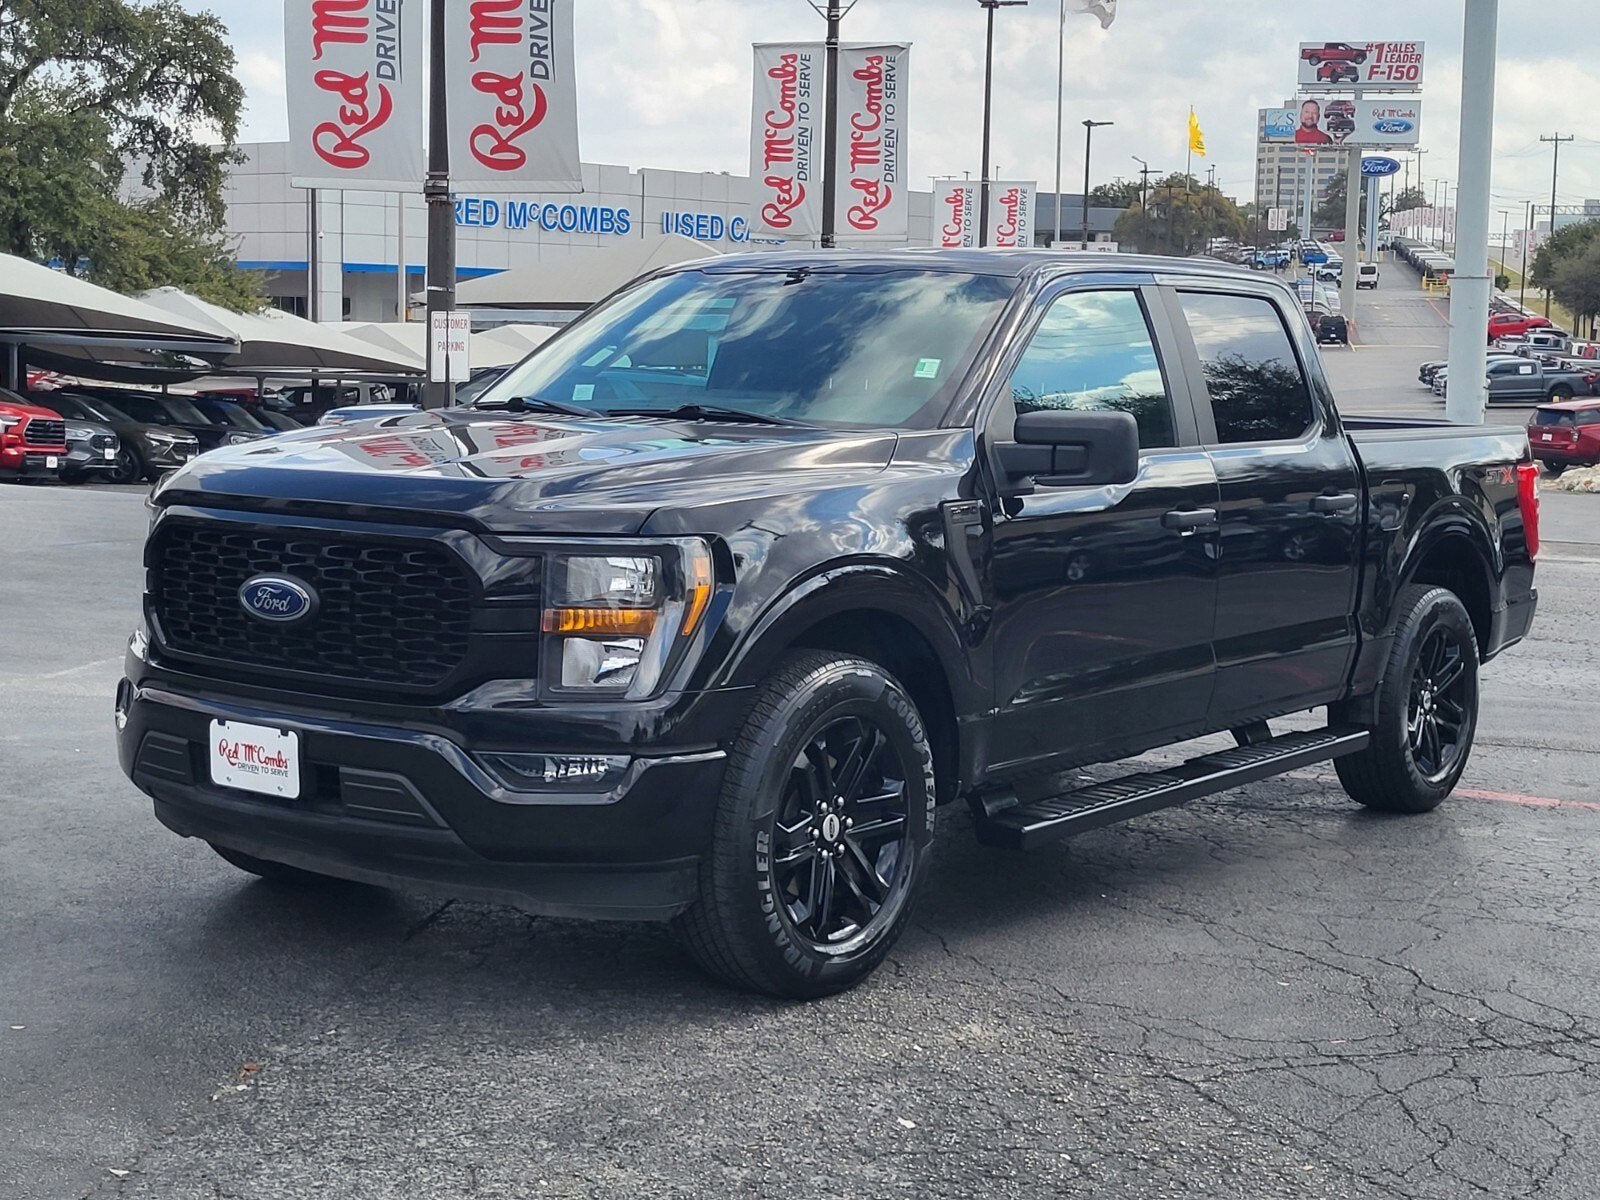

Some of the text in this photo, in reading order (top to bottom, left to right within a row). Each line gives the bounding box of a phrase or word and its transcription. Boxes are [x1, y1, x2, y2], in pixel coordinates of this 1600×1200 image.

[376, 0, 396, 81] DRIVE
[530, 0, 550, 80] DRIVE
[1365, 43, 1385, 64] #1
[1386, 43, 1415, 53] SALES
[1368, 65, 1419, 81] F-150
[1384, 54, 1421, 64] LEADER
[312, 70, 392, 169] Red
[469, 71, 547, 171] Red
[797, 53, 811, 181] DRIVEN TO SERVE
[884, 55, 896, 183] DRIVEN TO SERVE
[1381, 121, 1405, 132] Ford
[762, 53, 806, 228] Red McCombs
[847, 55, 892, 230] Red McCombs
[1361, 160, 1391, 172] Ford
[964, 188, 973, 216] SERVE
[1019, 188, 1028, 217] SERVE
[664, 211, 725, 240] USED
[964, 218, 972, 231] TO
[1018, 219, 1027, 232] TO
[1485, 467, 1514, 484] STX
[253, 586, 291, 612] Ford
[219, 738, 288, 769] Red McCombs
[237, 762, 289, 778] DRIVEN TO SERVE
